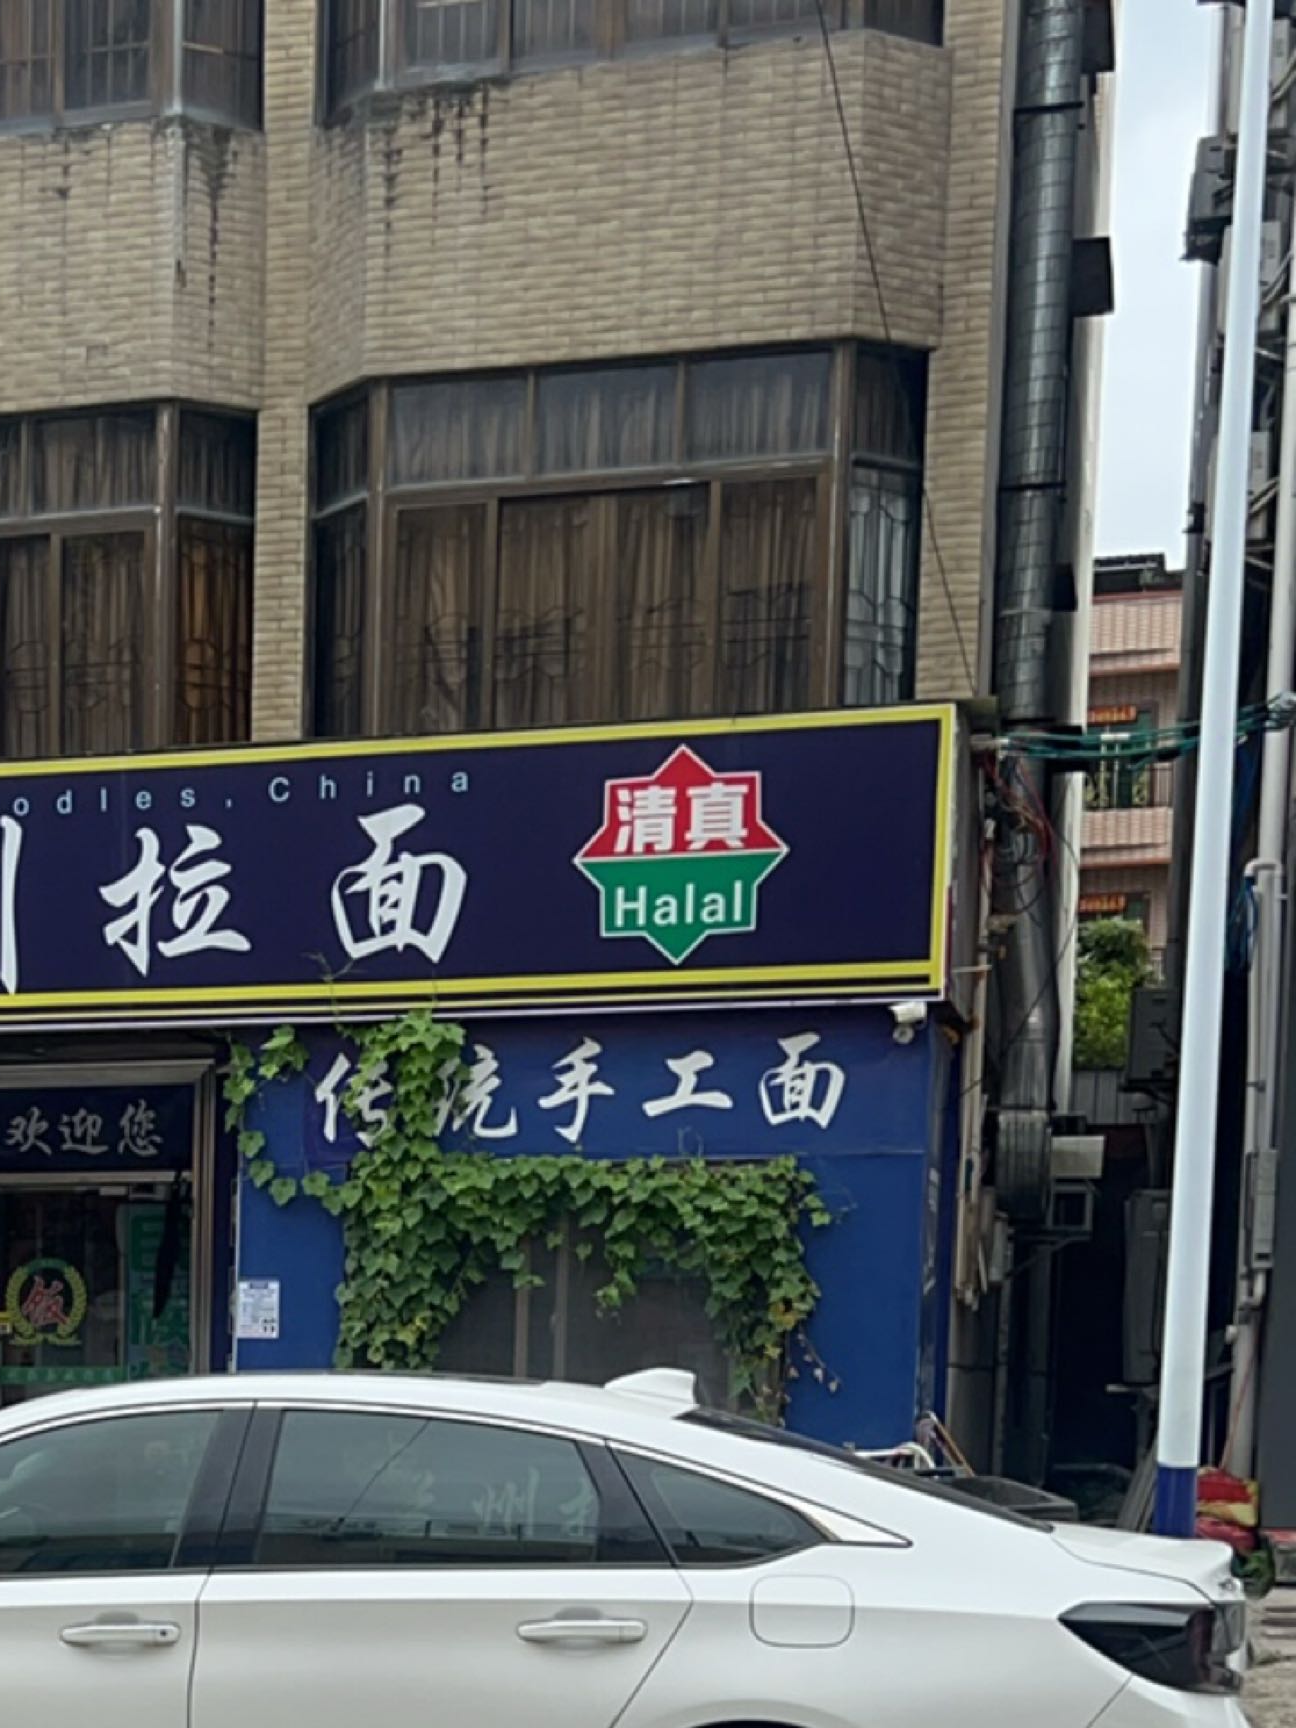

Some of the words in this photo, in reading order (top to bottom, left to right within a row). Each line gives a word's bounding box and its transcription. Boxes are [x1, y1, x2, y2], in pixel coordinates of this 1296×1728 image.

[268, 770, 468, 803] China
[614, 781, 749, 854] 清真
[614, 880, 743, 928] Halal
[315, 1032, 846, 1146] 传统手工面
